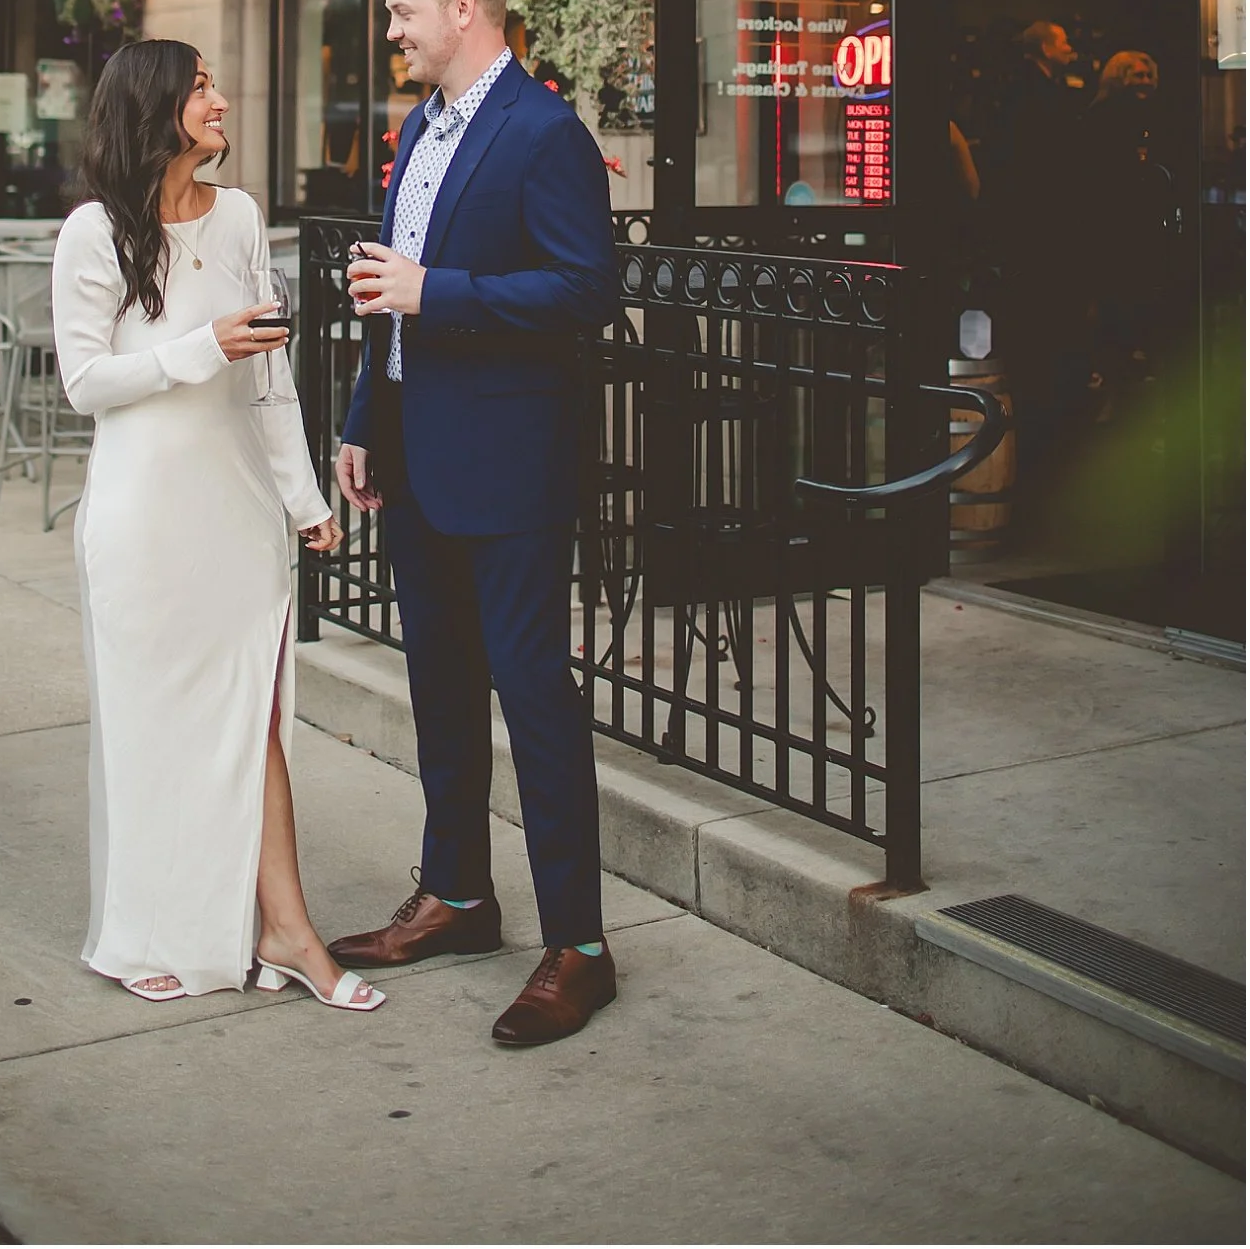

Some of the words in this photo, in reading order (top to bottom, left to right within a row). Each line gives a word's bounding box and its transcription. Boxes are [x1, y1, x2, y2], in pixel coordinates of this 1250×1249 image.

[846, 105, 883, 116] BUSINESS
[847, 120, 863, 130] MON
[846, 131, 860, 141] TUE
[846, 143, 862, 152] WED
[846, 154, 861, 163] THU
[845, 176, 858, 185] SAT
[845, 188, 860, 197] SUN
